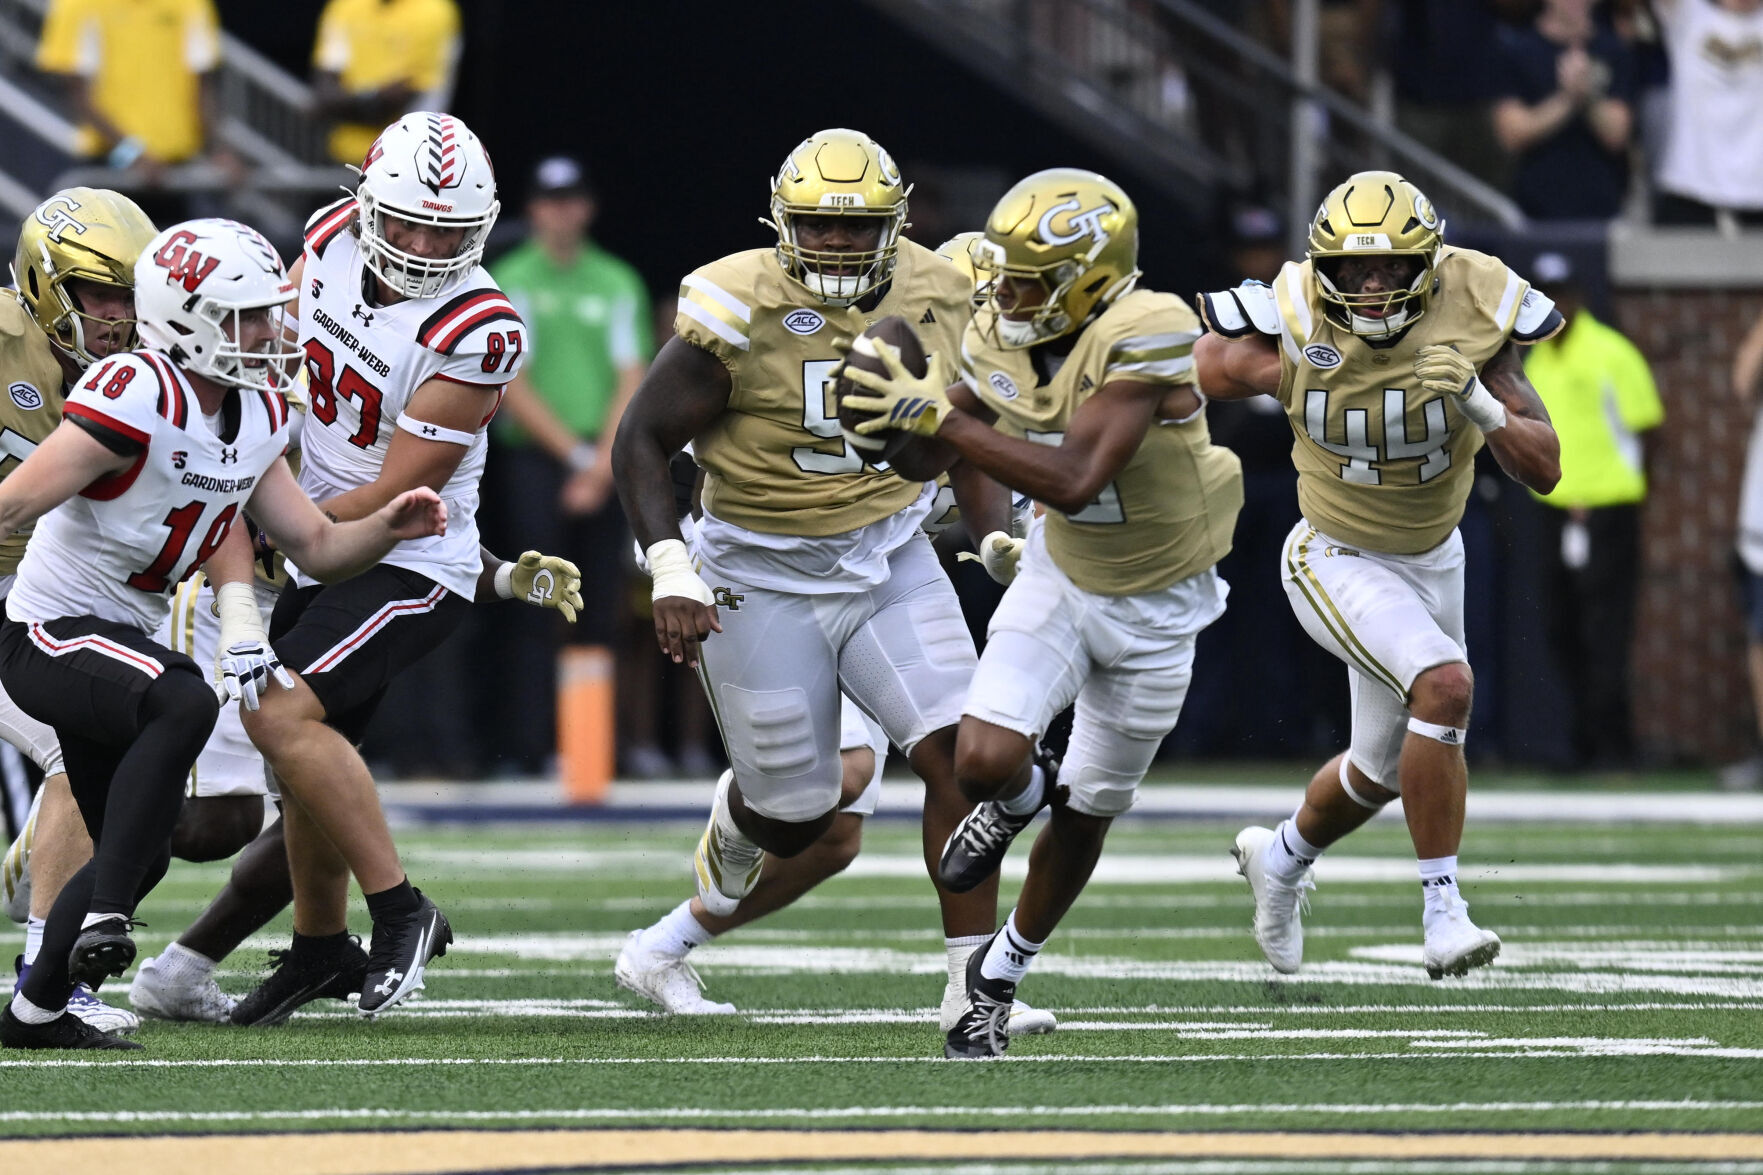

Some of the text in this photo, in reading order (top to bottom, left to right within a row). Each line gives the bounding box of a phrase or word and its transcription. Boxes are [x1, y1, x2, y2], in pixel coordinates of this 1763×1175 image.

[35, 195, 87, 244] GT
[422, 199, 453, 213] DAWGS
[830, 195, 855, 207] TECH
[1037, 199, 1114, 247] GT
[1356, 235, 1376, 246] TECH
[155, 229, 221, 293] GW
[791, 315, 817, 327] ACC
[312, 308, 391, 378] GARDNER-WEBB
[480, 330, 522, 374] 87
[1309, 349, 1335, 363] ACC
[14, 389, 38, 404] ACC
[84, 360, 137, 400] 18
[302, 336, 384, 450] 87
[1304, 388, 1452, 487] 44
[712, 586, 745, 613] GT
